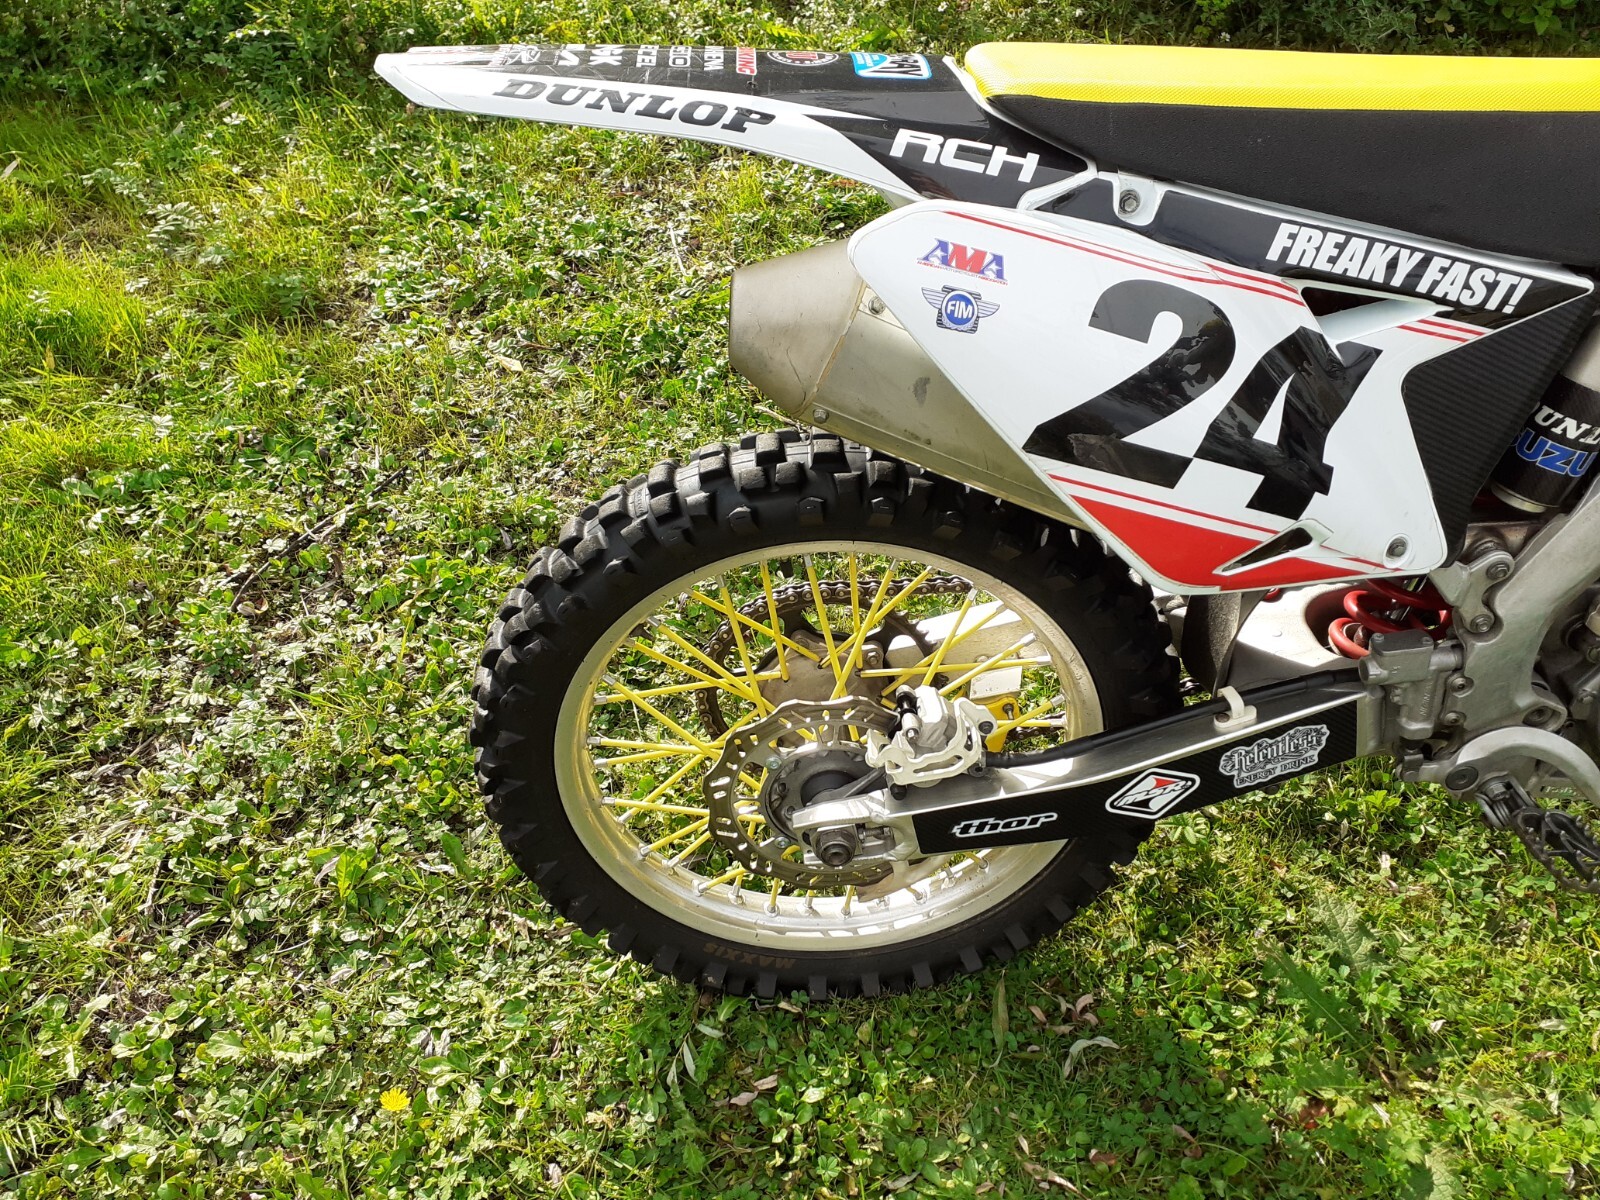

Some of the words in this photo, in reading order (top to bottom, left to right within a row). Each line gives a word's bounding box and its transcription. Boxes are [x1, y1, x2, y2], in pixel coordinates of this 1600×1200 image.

[492, 78, 777, 133] DUNLOP
[889, 128, 1040, 183] RCH
[916, 237, 1008, 282] AMA
[1265, 222, 1425, 288] FREAKY
[1415, 255, 1533, 315] FAST!
[947, 300, 973, 320] FIM
[1024, 279, 1383, 522] 24
[1514, 427, 1598, 477] UZU
[1229, 731, 1323, 773] Relentless
[1236, 766, 1278, 785] ENERGY
[1280, 754, 1316, 772] DRINK
[1114, 780, 1192, 808] MSR
[953, 812, 1058, 837] thor
[703, 942, 797, 969] MAXXIS
